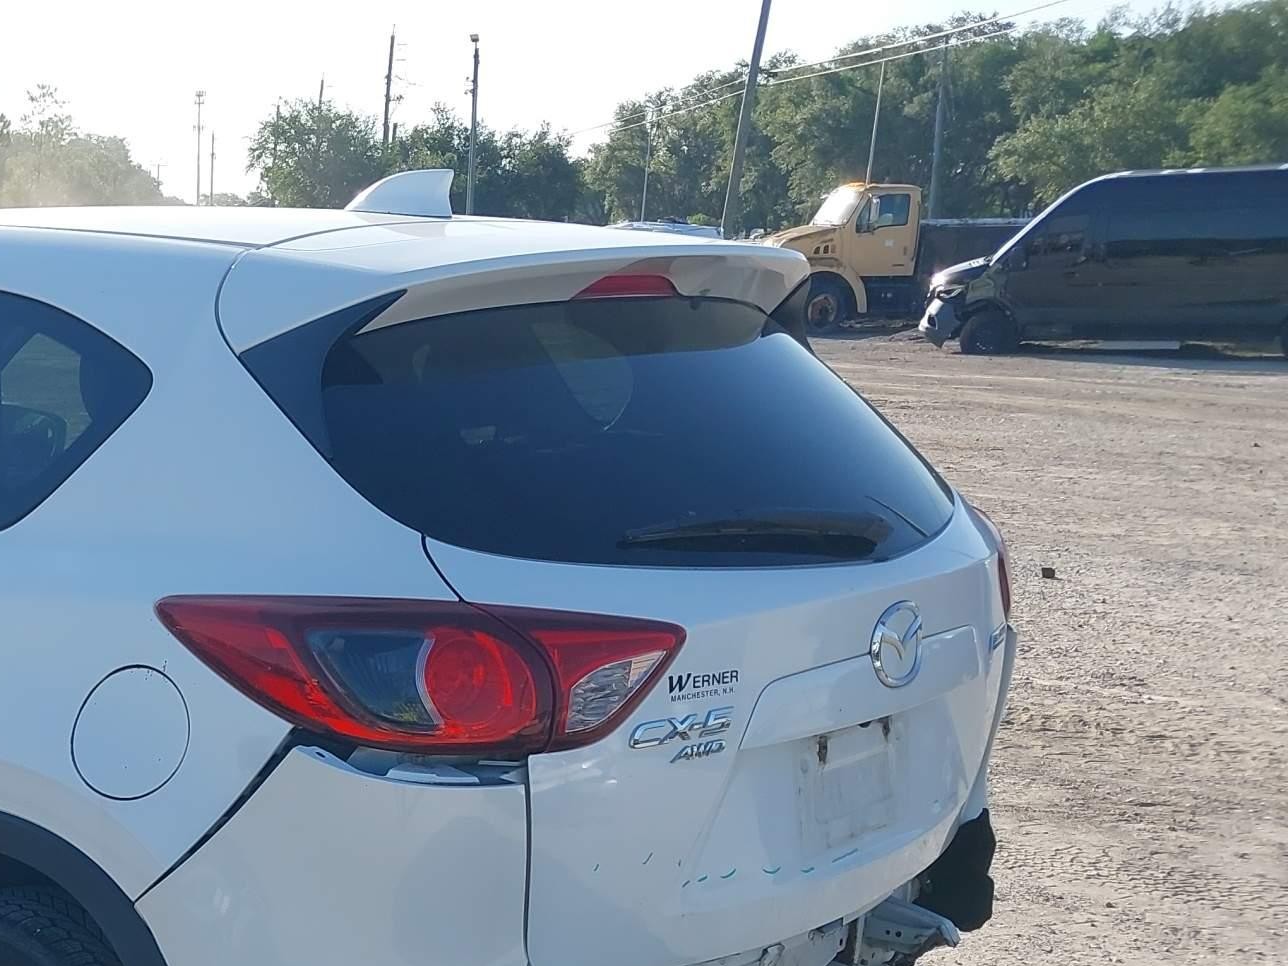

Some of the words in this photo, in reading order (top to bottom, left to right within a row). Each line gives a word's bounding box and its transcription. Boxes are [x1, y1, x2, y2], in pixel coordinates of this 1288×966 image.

[668, 670, 739, 694] WERNER
[670, 689, 720, 703] MANCHESTER,
[722, 687, 735, 696] N.H.
[628, 706, 734, 749] CX-5
[669, 739, 726, 764] AWD
